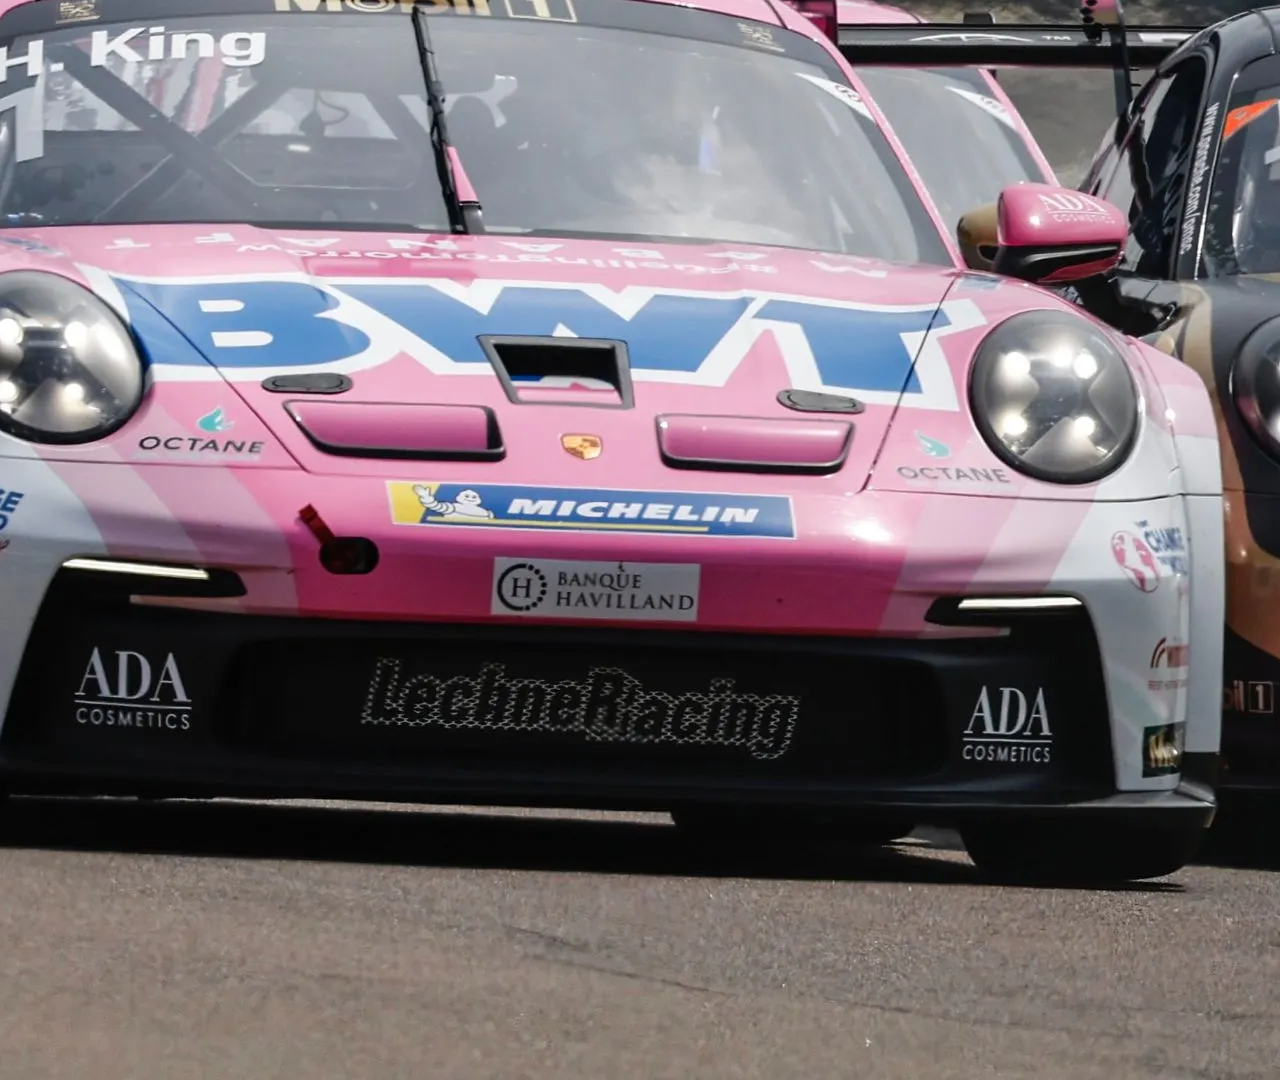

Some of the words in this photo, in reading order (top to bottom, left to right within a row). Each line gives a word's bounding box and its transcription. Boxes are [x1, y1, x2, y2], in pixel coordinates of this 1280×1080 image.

[91, 26, 266, 68] King
[108, 273, 960, 400] BWT
[139, 435, 264, 455] OCTANE
[897, 465, 1010, 483] OCTANE
[507, 497, 760, 523] MICHELIN
[558, 571, 642, 592] BANQUE
[556, 591, 694, 612] HAVILLAND
[75, 647, 192, 702] ADA
[76, 707, 191, 729] COSMETICS
[963, 685, 1053, 736] ADA
[962, 744, 1051, 763] COSMETICS
